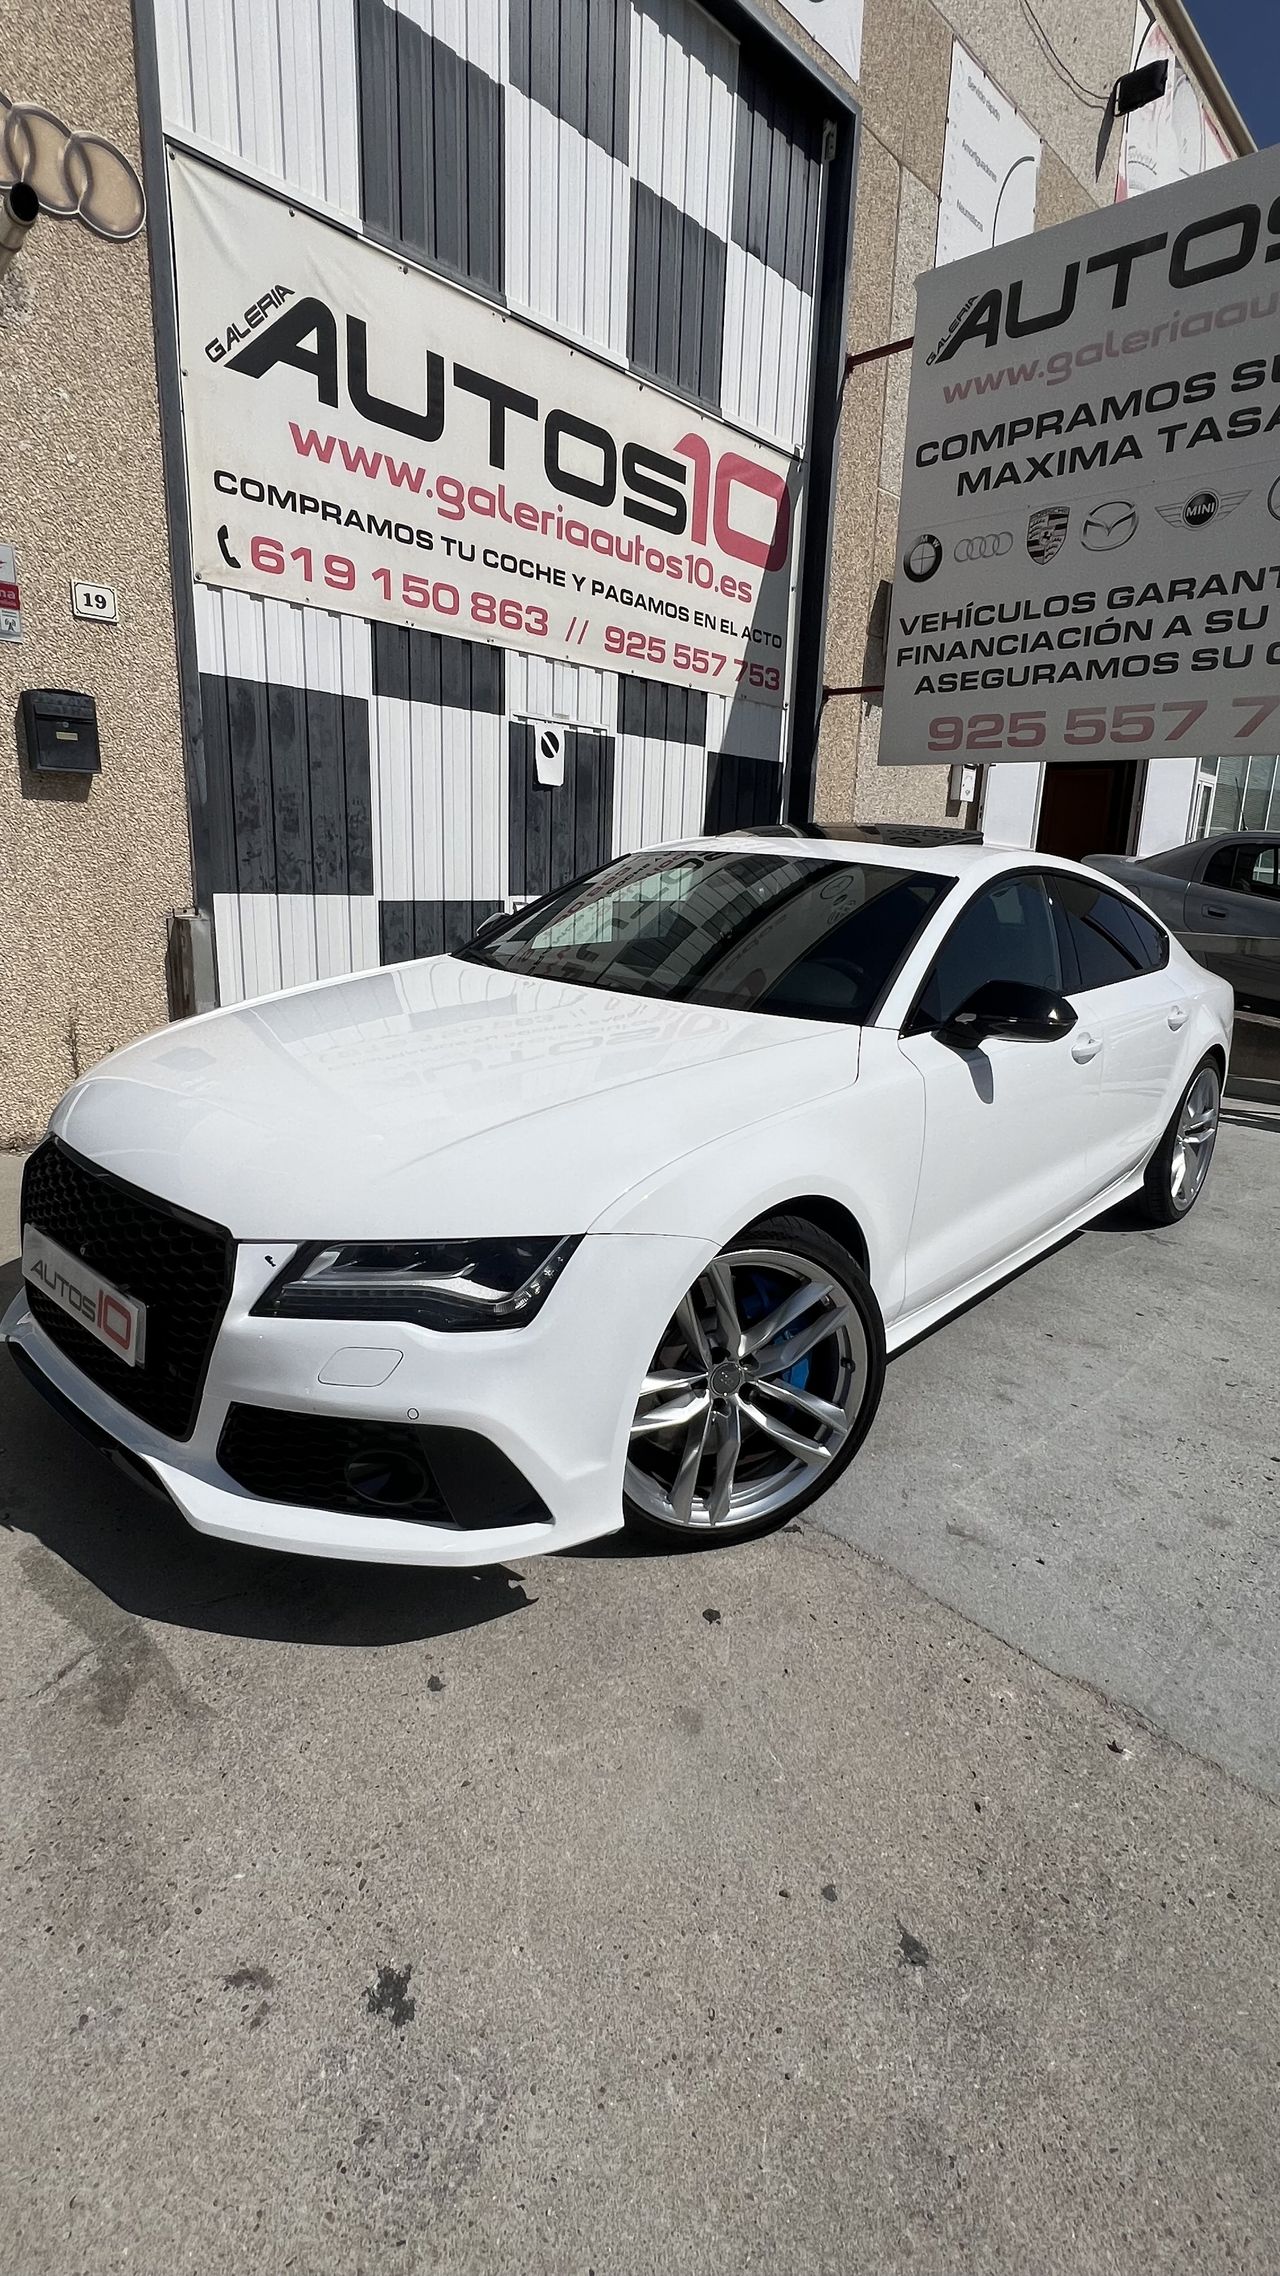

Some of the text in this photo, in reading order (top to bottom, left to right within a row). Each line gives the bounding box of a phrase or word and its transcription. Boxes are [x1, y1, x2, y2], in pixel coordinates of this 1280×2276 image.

[934, 195, 1280, 365] AUTO
[204, 284, 296, 363] GALERIA
[925, 295, 980, 366] GALERIA
[915, 354, 1280, 468] COMPRAMOS S
[957, 435, 1143, 496] MAXIMA
[288, 421, 752, 603] www.galeriaautos10.es
[1186, 502, 1215, 518] MINI
[213, 470, 783, 648] COMPRAMOS TU COCHE Y PAGAMOS EN EL ACTO
[83, 592, 107, 609] 19
[250, 535, 356, 591] 619
[371, 567, 460, 616] 150
[470, 591, 548, 637] 863
[604, 625, 666, 664] 925
[672, 643, 727, 677] 557
[733, 659, 780, 690] 753
[899, 591, 1097, 636] VEHÍCULOS
[896, 605, 1269, 667] FINANCIACIÓN A SU
[914, 652, 1180, 695] ASEGURAMOS
[1191, 644, 1254, 671] SU
[927, 710, 1047, 751] 925
[1063, 700, 1208, 746] 557
